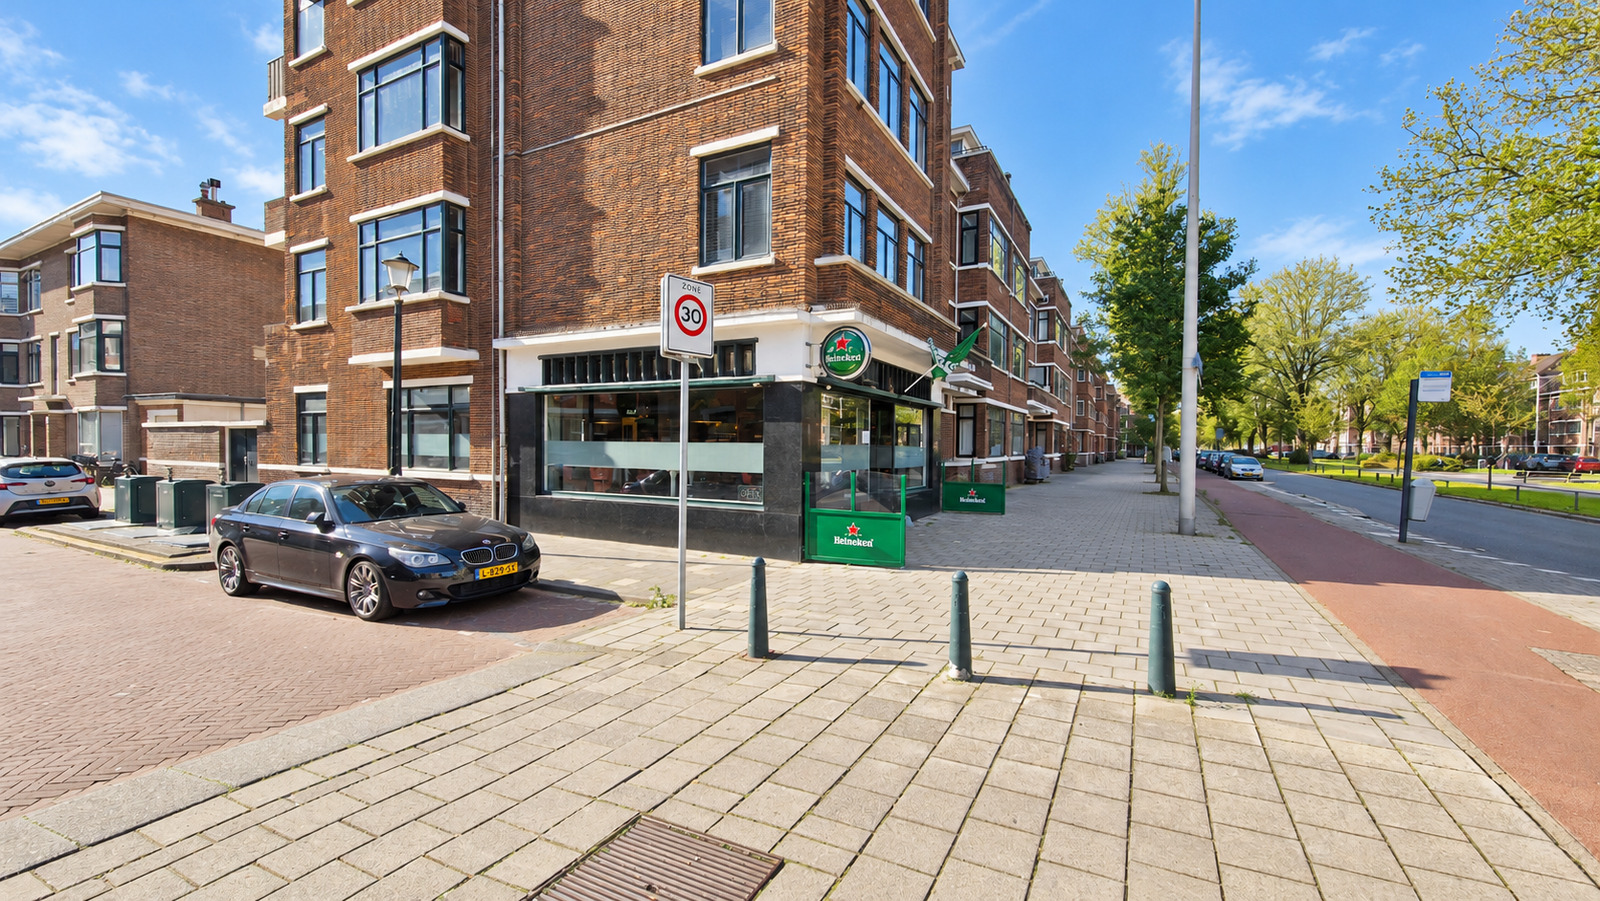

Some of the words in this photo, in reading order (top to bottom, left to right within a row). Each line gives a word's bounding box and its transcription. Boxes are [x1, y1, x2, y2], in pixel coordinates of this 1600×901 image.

[682, 282, 701, 294] ZONE
[681, 306, 702, 325] 30
[833, 535, 873, 547] Heineken
